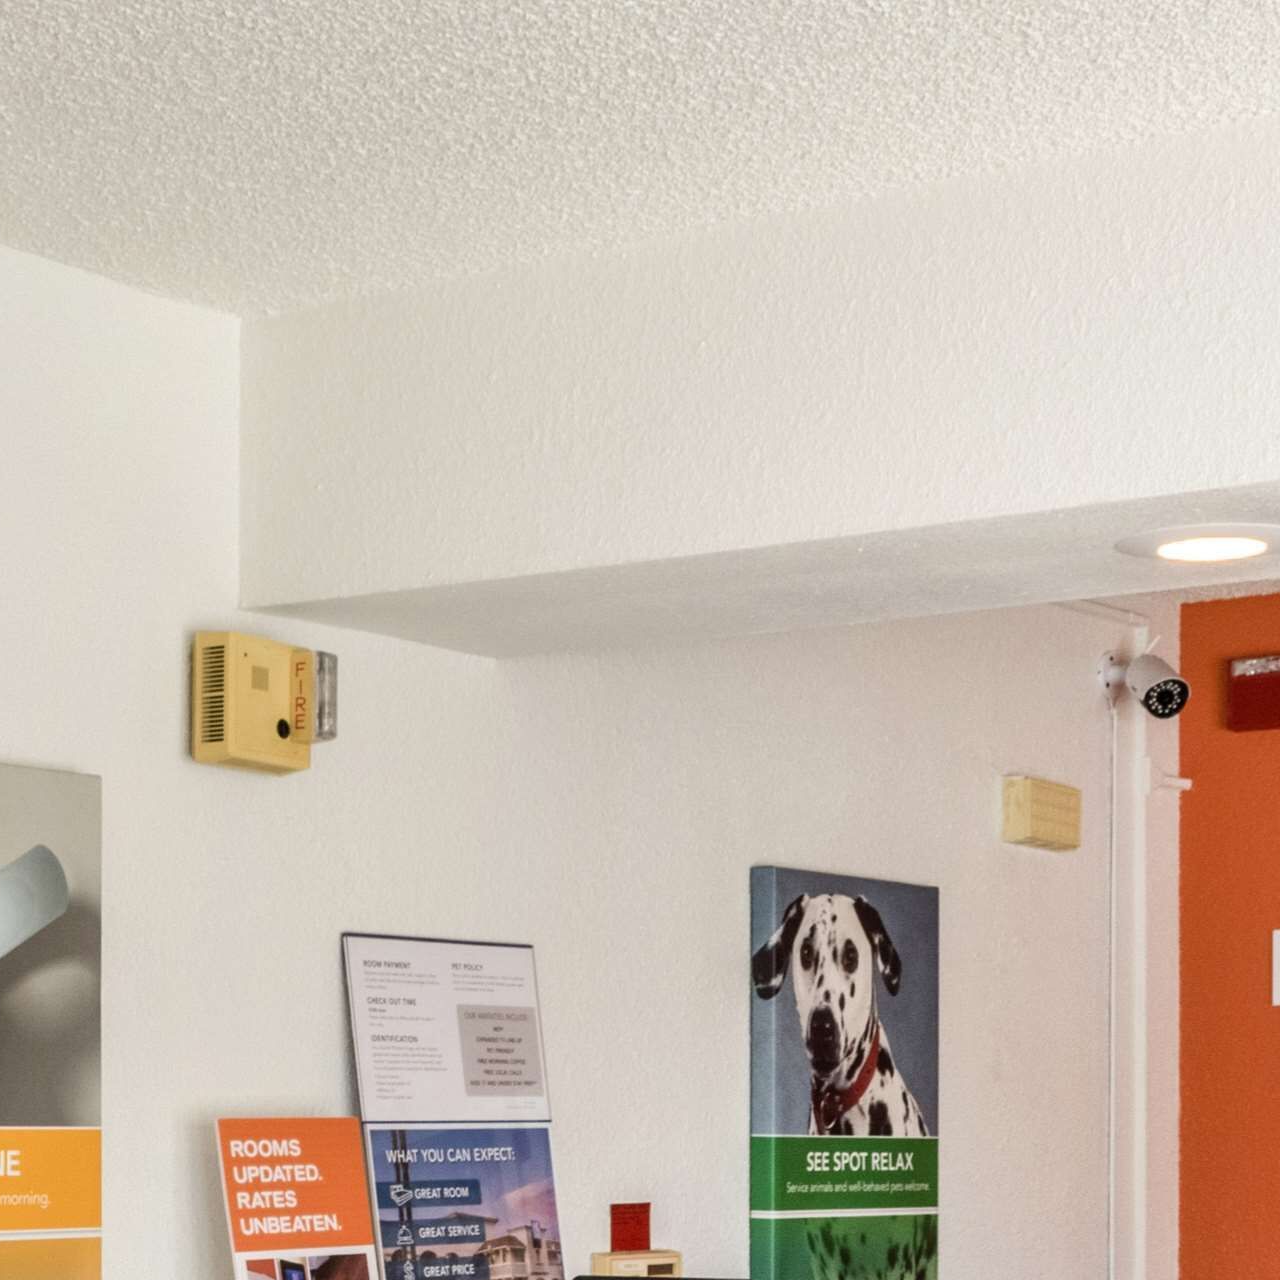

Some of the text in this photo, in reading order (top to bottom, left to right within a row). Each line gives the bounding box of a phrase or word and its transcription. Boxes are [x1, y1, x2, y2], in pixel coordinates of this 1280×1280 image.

[294, 661, 307, 731] FIRE
[229, 1138, 302, 1158] ROOMS
[385, 1147, 516, 1164] WHAT YOU CAN EXPECT:
[806, 1151, 914, 1172] SEE SPOT RELAX
[232, 1164, 323, 1185] UPDATED.
[414, 1186, 470, 1200] GREAT ROOM
[786, 1181, 809, 1194] Service
[0, 1191, 51, 1209] morning.
[235, 1189, 298, 1210] RATES
[239, 1214, 343, 1236] UNBEATEN.
[418, 1224, 481, 1239] GREAT SERVICE
[423, 1263, 476, 1278] GREAT PRICE
